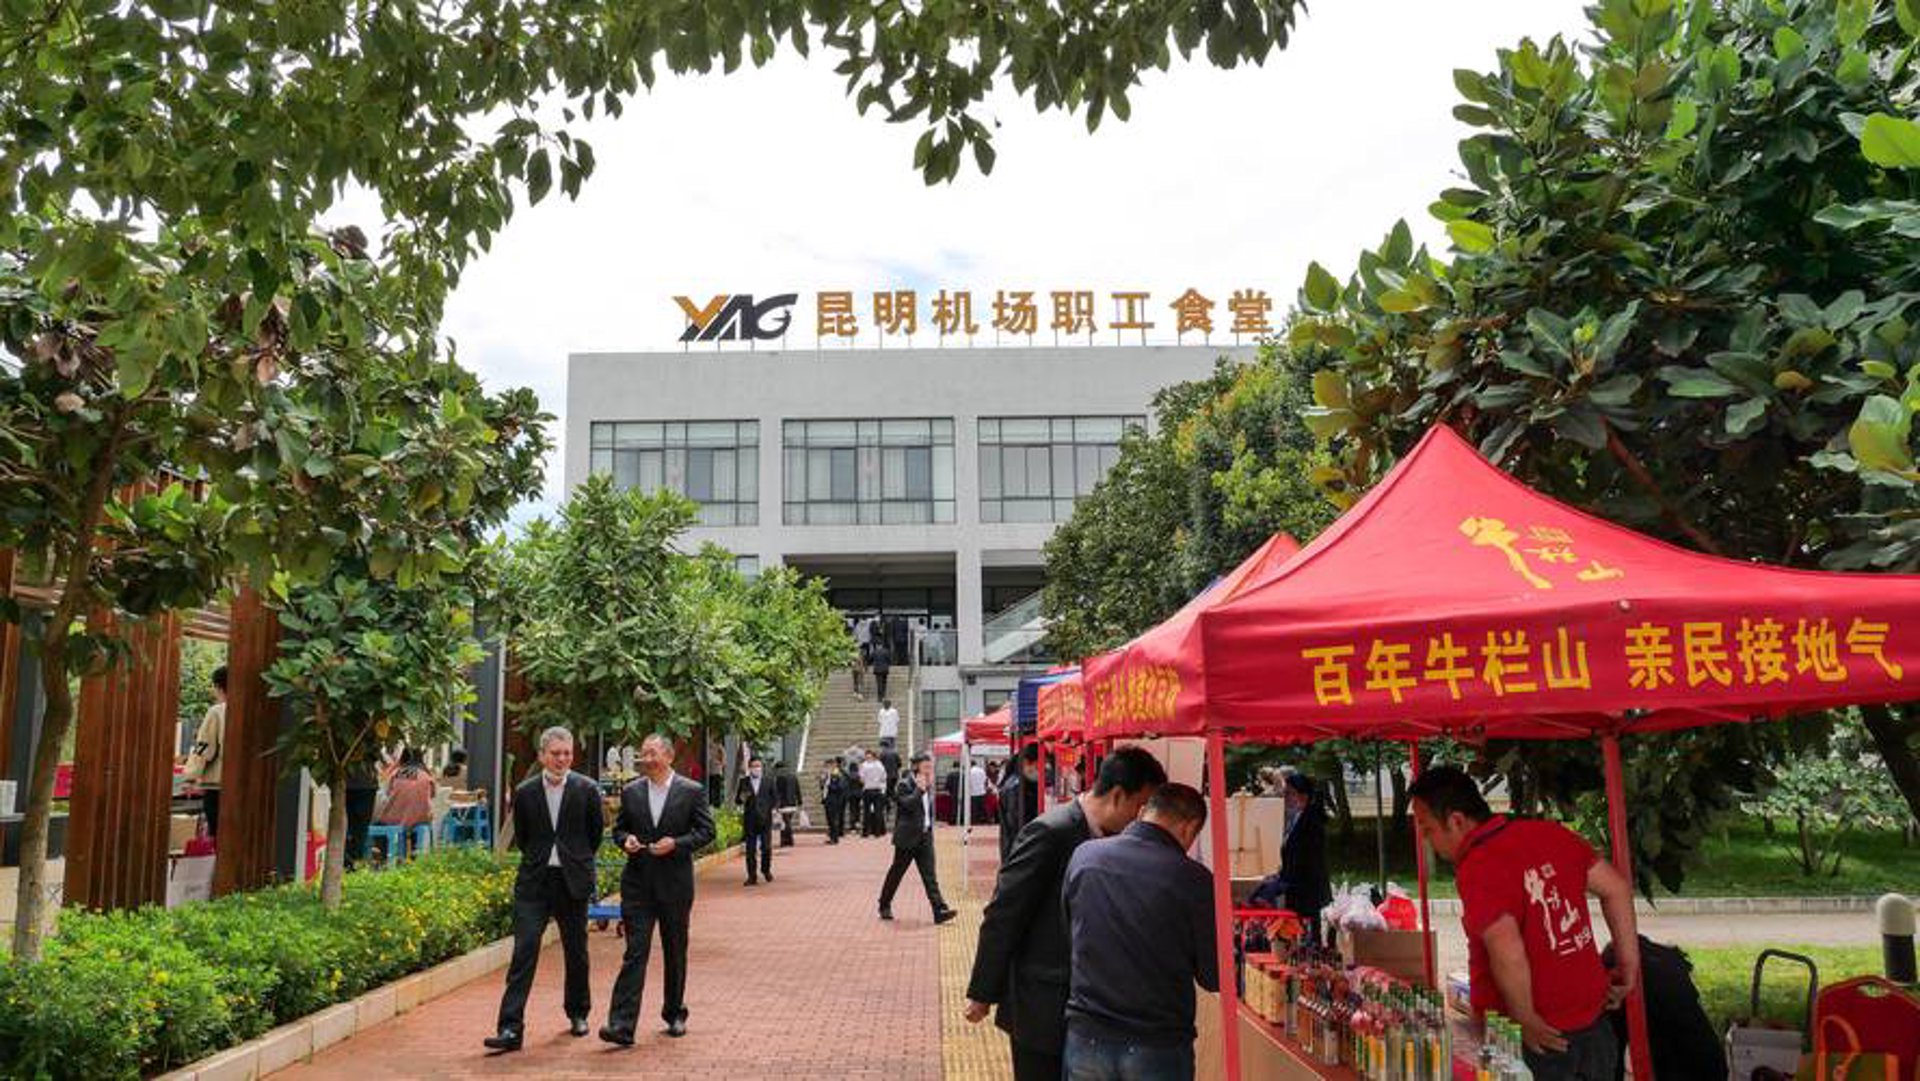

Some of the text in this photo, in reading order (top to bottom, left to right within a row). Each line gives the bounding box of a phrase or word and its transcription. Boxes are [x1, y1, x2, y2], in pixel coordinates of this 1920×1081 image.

[815, 288, 1275, 336] 昆明机场职工食堂
[1302, 617, 1903, 705] 百年牛栏山 亲民接地气
